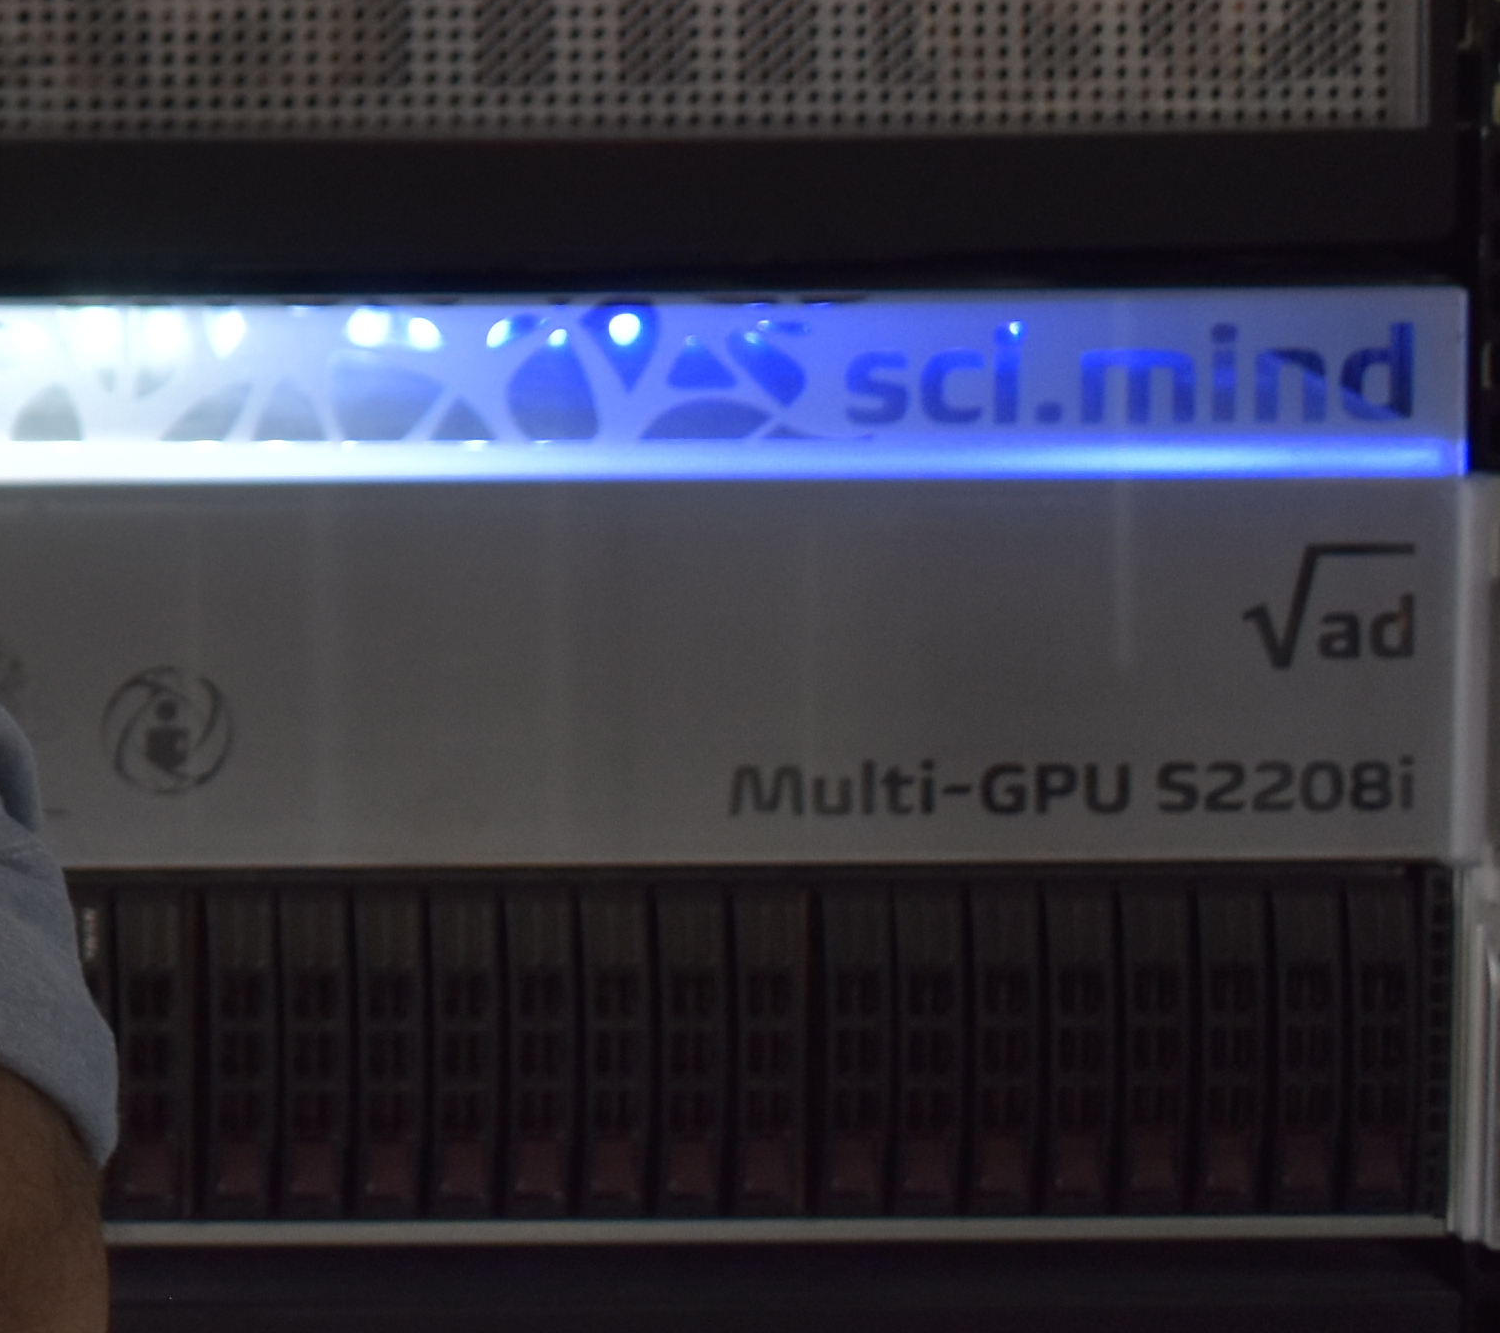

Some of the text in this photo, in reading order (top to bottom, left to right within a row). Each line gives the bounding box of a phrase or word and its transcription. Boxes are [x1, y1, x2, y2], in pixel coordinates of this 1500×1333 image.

[844, 320, 1416, 427] sci.mind
[730, 755, 1414, 817] Multi-GPU S2208i
